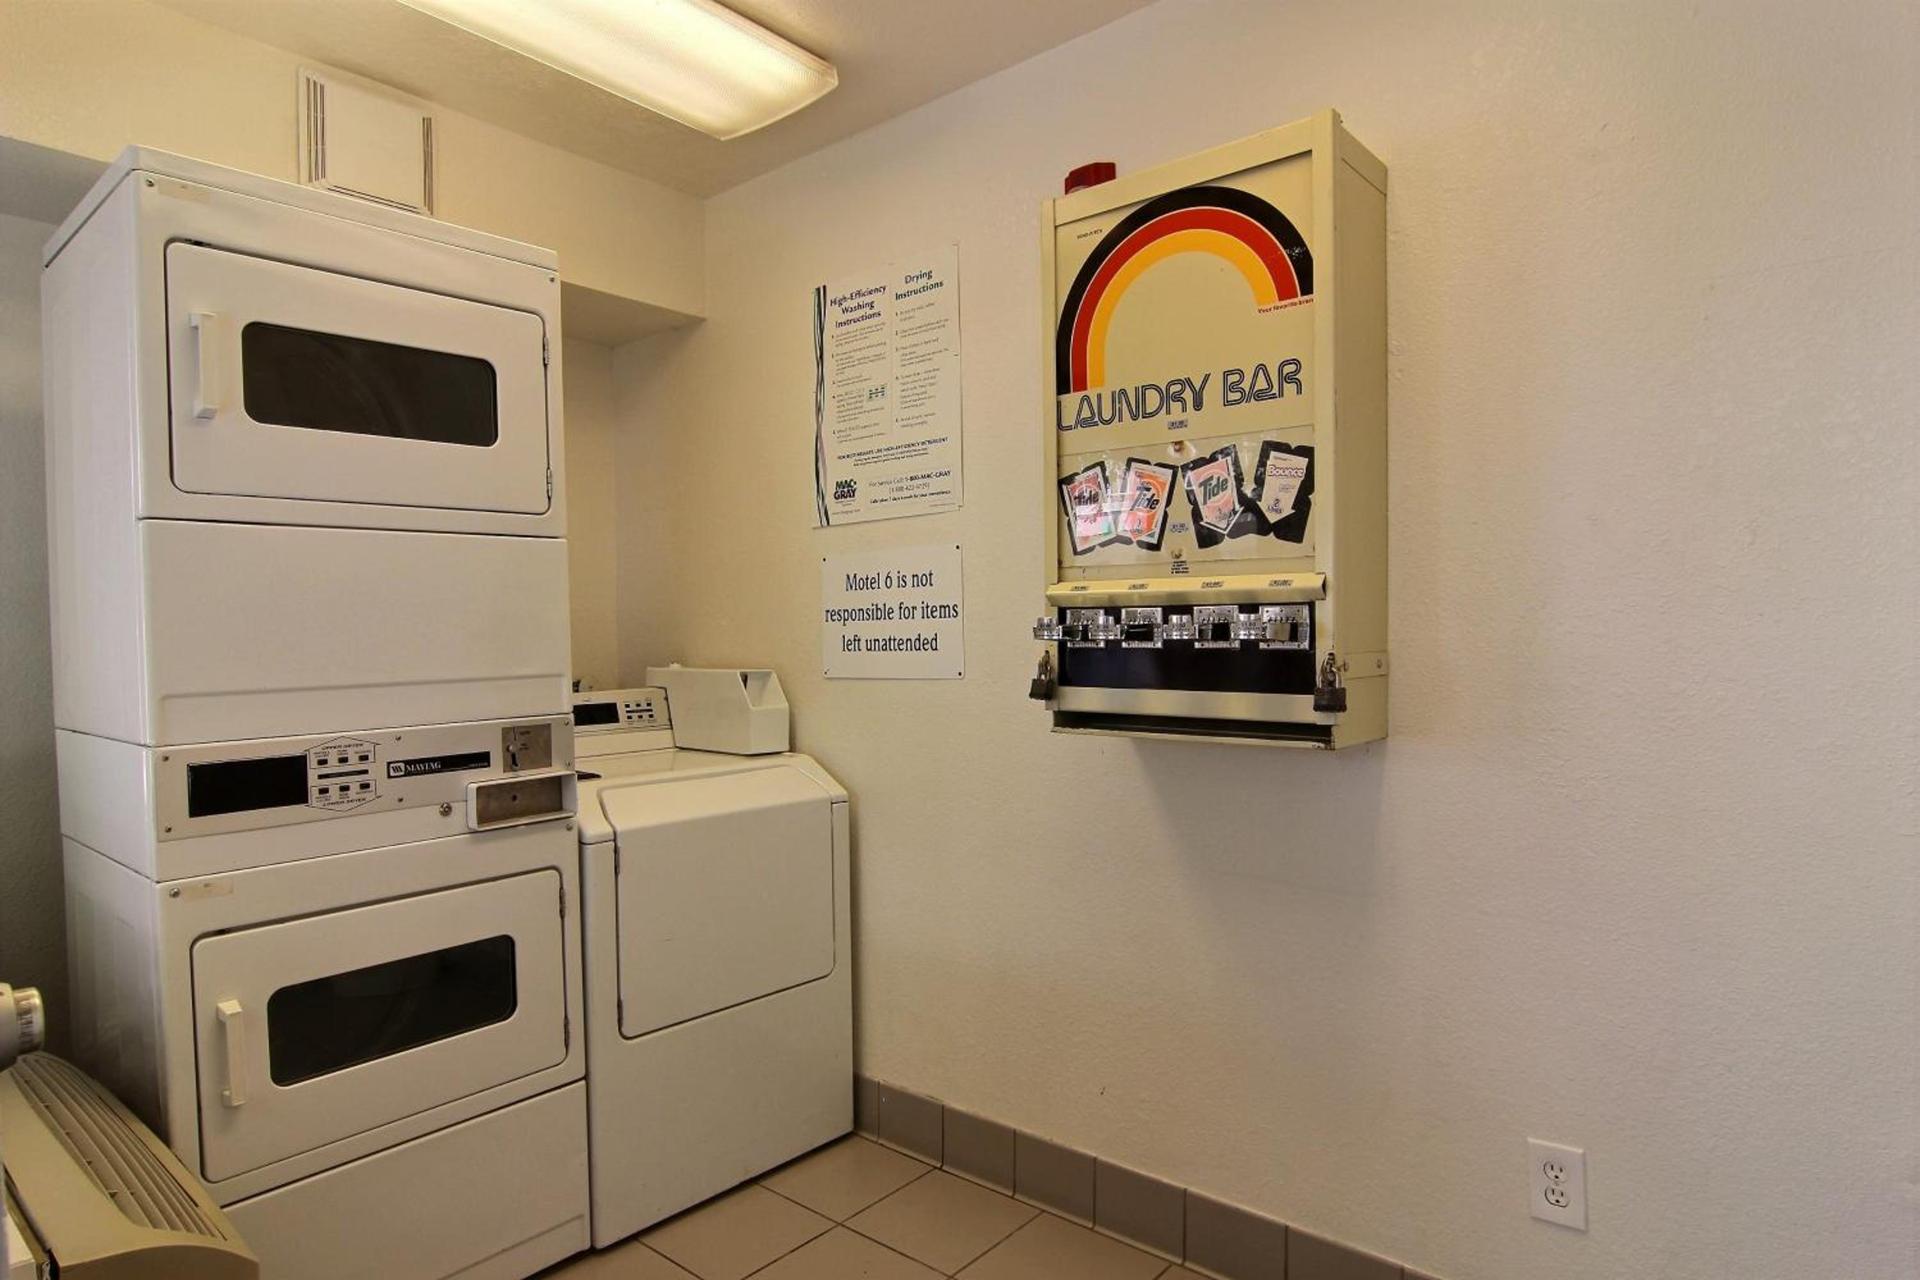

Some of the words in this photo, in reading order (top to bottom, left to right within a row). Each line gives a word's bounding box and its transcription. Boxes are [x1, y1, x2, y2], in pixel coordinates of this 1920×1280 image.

[904, 269, 933, 284] Drying
[830, 285, 887, 307] High-Efficiency
[895, 280, 945, 300] Instructions
[841, 299, 875, 315] Washing
[835, 310, 882, 329] Instructions
[1057, 373, 1211, 432] LAUNDRY
[1222, 358, 1302, 408] BAR
[1267, 464, 1304, 478] Bounce
[834, 487, 857, 500] GRAY
[1130, 485, 1160, 511] Tide
[1199, 475, 1229, 505] Tide
[845, 572, 880, 591] Motel
[885, 571, 893, 589] 6
[897, 570, 907, 588] is
[911, 570, 934, 588] not
[825, 603, 894, 626] responsible
[898, 602, 917, 620] for
[921, 601, 959, 619] items
[842, 634, 862, 652] left
[865, 633, 939, 652] unattended
[406, 762, 441, 772] MAYTAG
